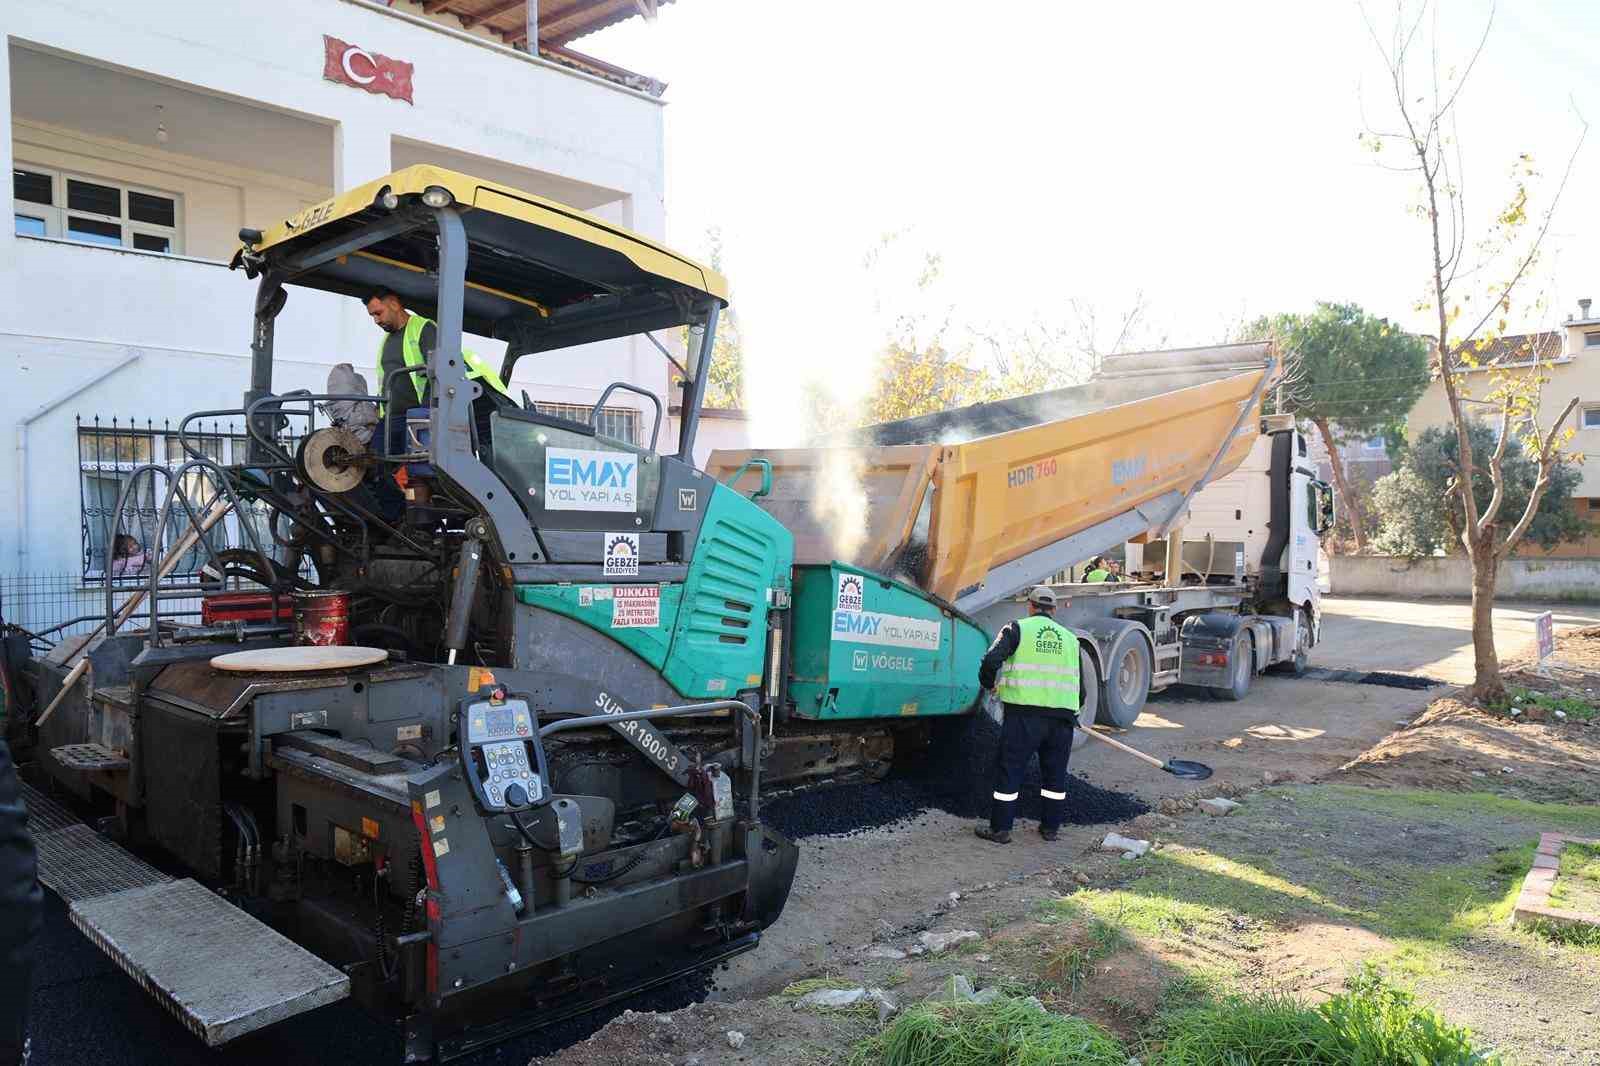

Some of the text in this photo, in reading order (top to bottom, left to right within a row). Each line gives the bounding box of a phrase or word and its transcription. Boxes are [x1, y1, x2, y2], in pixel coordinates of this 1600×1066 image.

[549, 458, 634, 488] EMAY
[1008, 457, 1057, 488] HDR 760
[550, 490, 575, 501] YOL
[581, 491, 609, 502] YAPI
[607, 557, 637, 567] GEBZE
[840, 594, 861, 605] GEBZE
[834, 612, 881, 636] EMAY
[884, 626, 902, 639] YOL
[1036, 641, 1062, 650] GEBZE
[872, 651, 914, 671] VÖGELE
[638, 728, 678, 770] 1800-3
